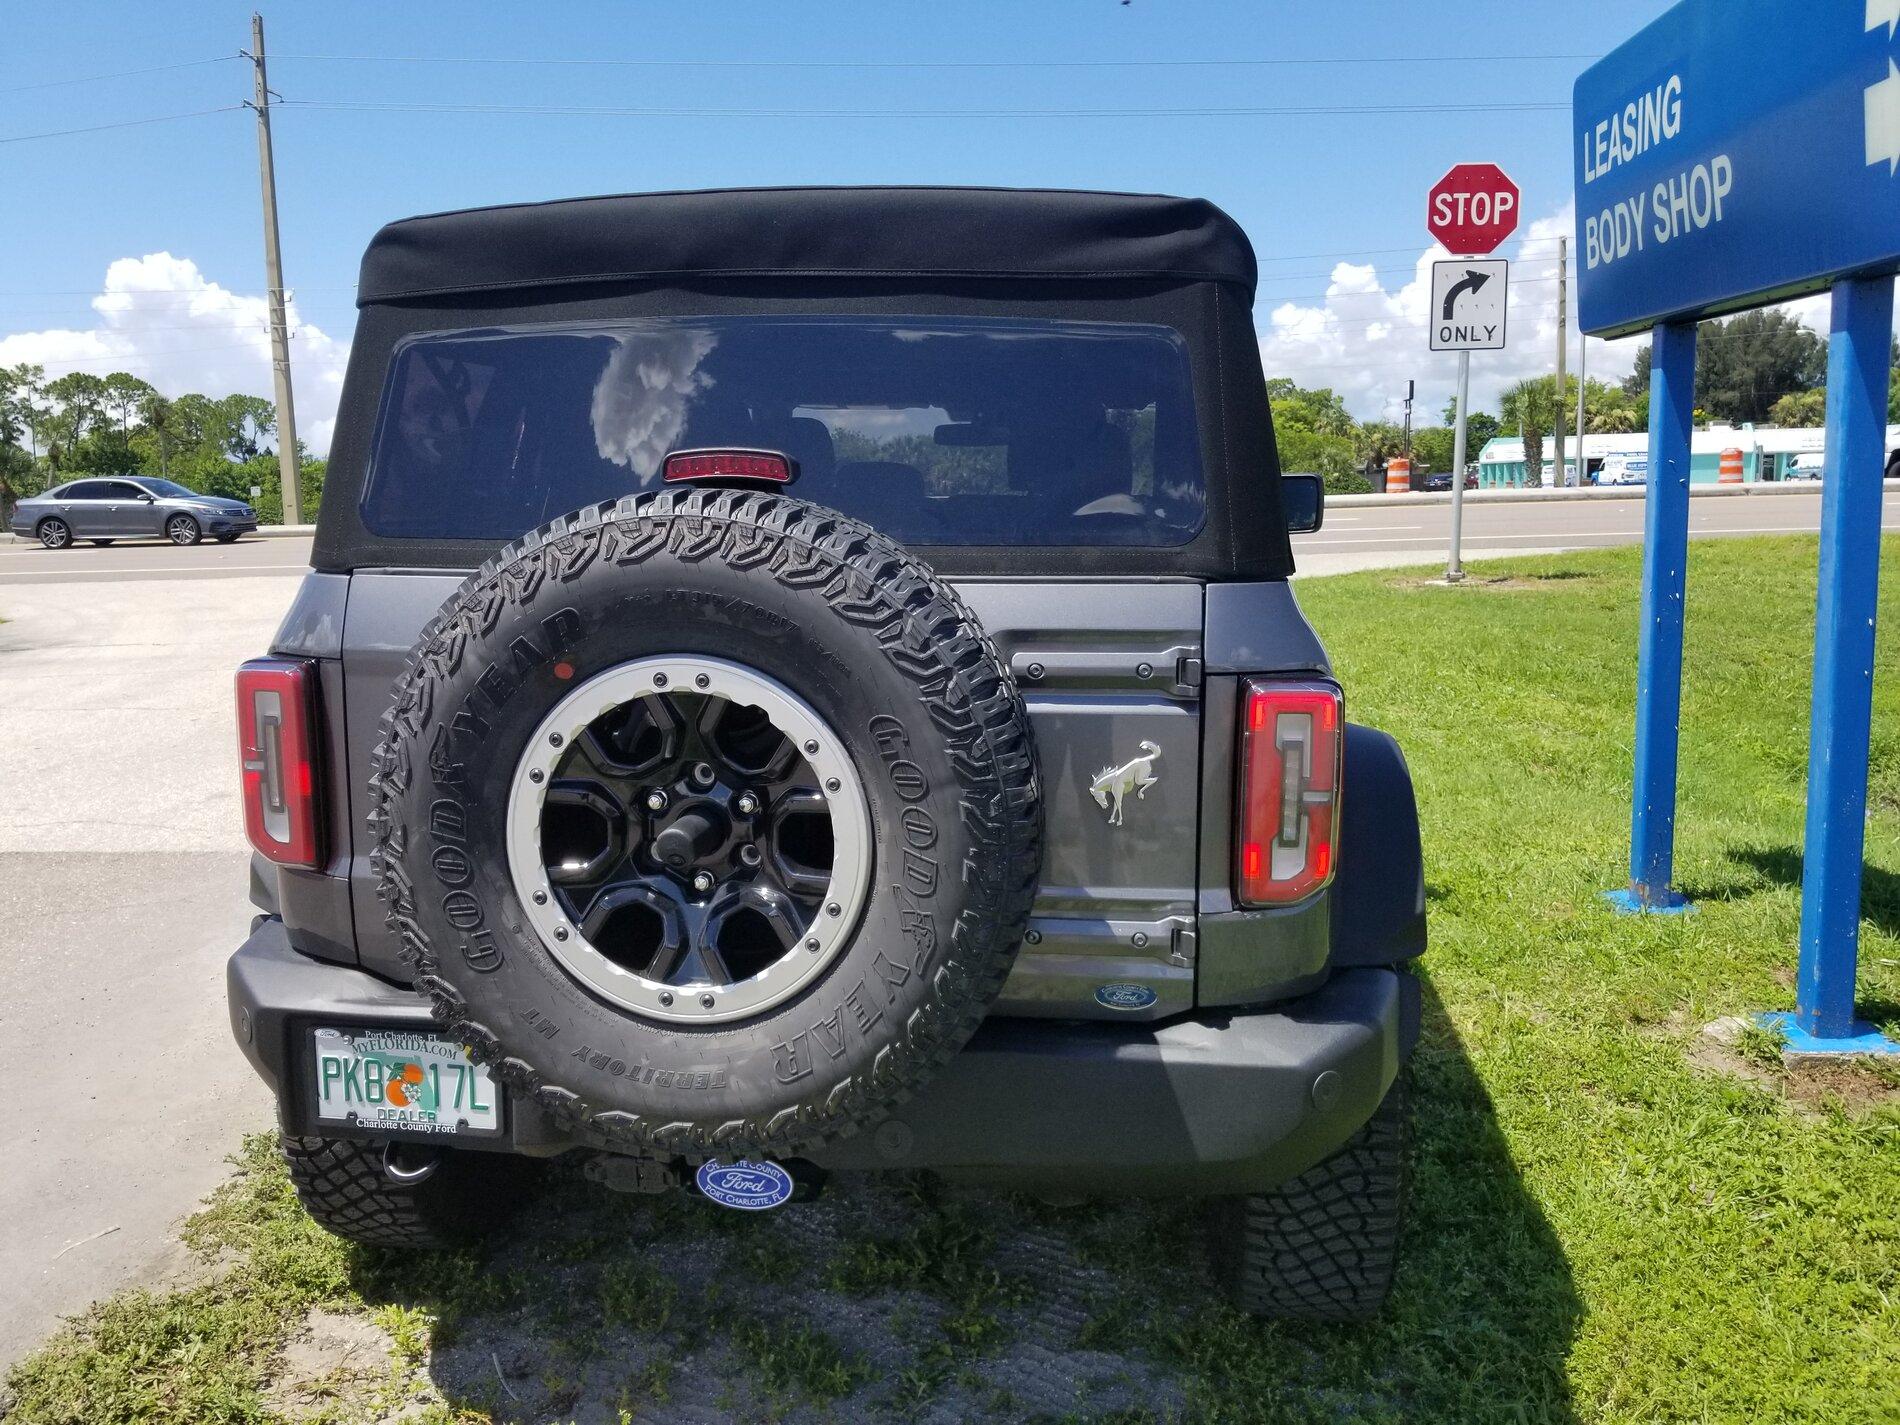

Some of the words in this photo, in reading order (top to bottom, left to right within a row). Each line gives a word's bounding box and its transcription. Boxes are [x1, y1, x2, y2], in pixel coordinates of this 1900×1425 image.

[1584, 74, 1682, 184] LEASING
[1432, 191, 1514, 227] STOP
[1585, 192, 1646, 270] BODY
[1652, 154, 1733, 244] SHOP
[1439, 324, 1497, 343] ONLY
[519, 1007, 561, 1040] MT
[365, 1030, 383, 1040] Port
[428, 1034, 440, 1042] FL
[352, 1039, 458, 1060] MYFLORIDA.COM
[570, 1045, 727, 1090] TERRITORY
[321, 1055, 384, 1104] PK8
[377, 1107, 438, 1123] DEALER
[356, 1118, 398, 1130] Charlotte
[400, 1120, 433, 1134] County
[434, 1123, 457, 1134] Ford
[704, 1184, 724, 1199] PORT
[772, 1193, 783, 1201] FL
[721, 1172, 765, 1193] Ford
